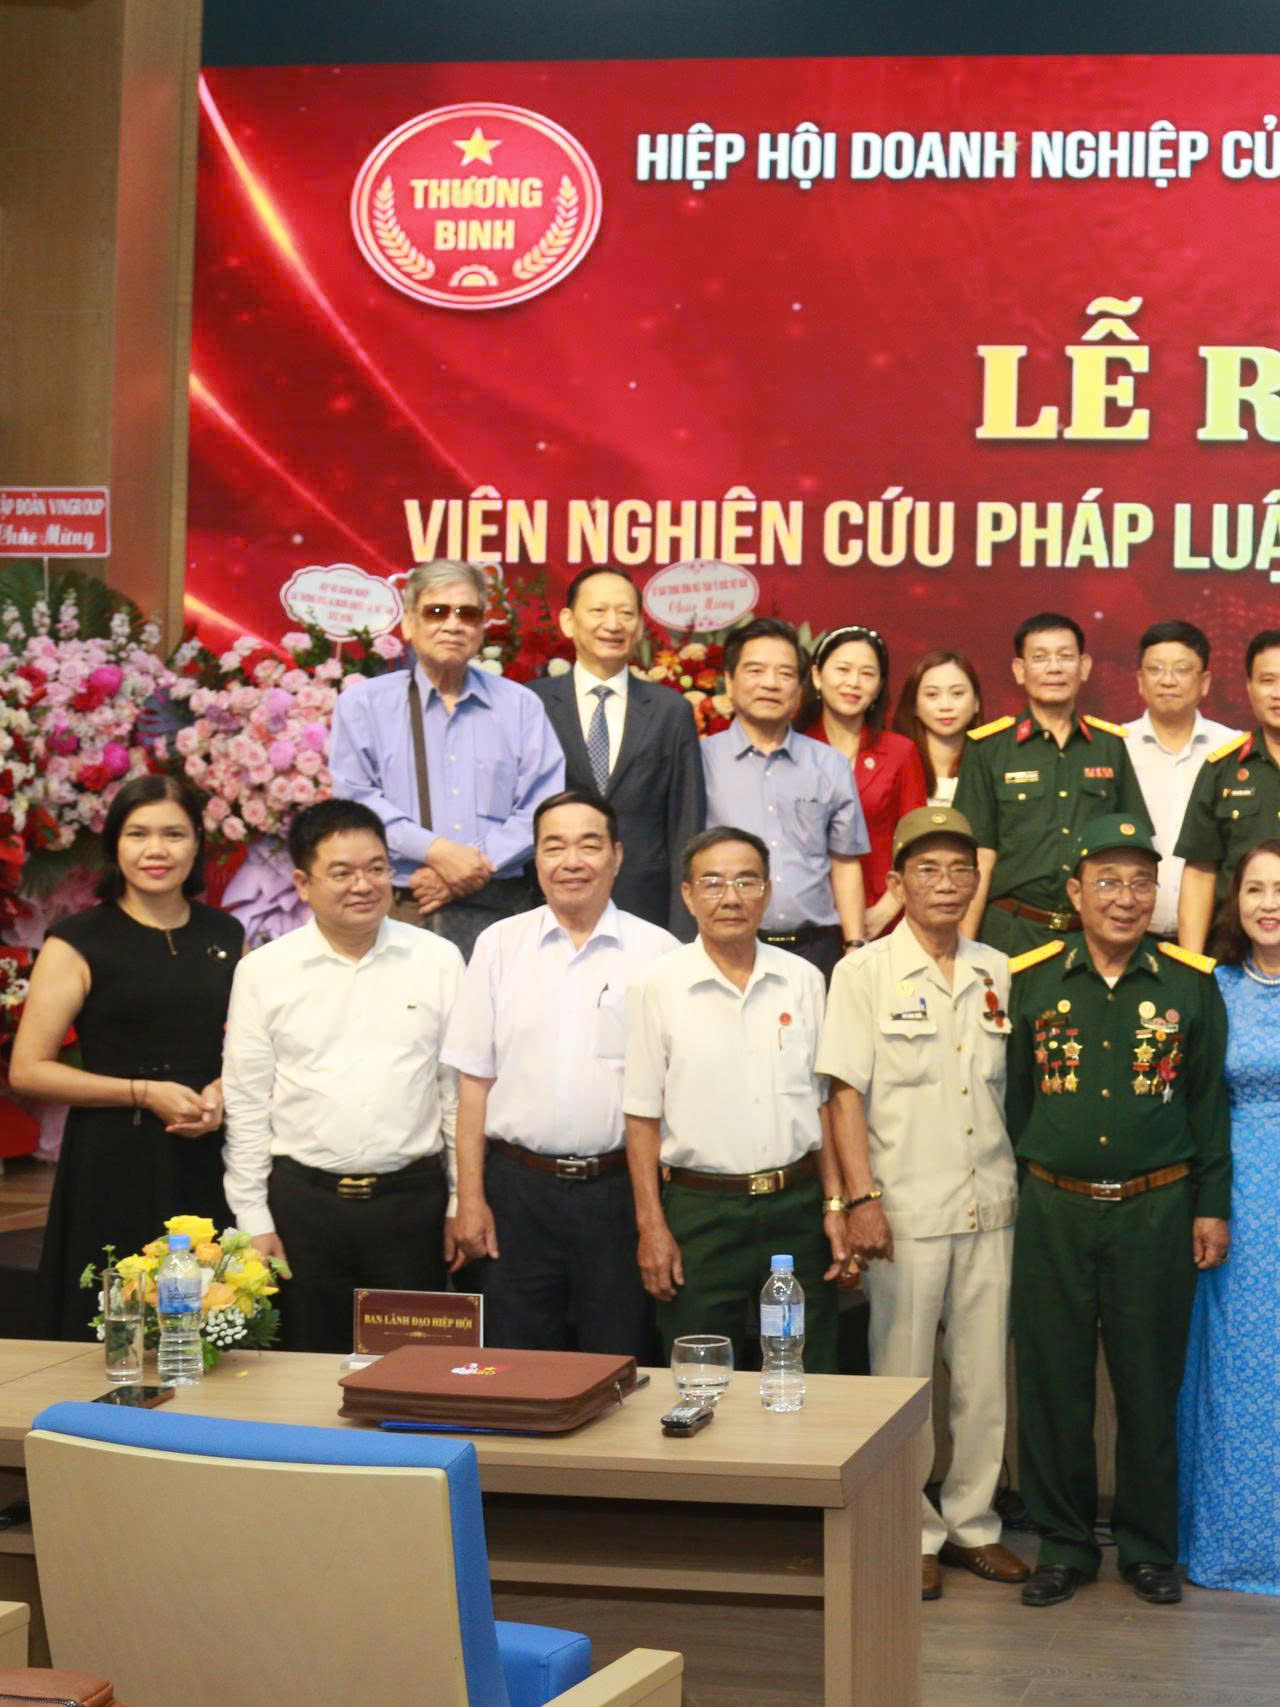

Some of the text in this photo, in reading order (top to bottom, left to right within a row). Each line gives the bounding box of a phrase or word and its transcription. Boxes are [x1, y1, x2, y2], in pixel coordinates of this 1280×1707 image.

[636, 122, 746, 190] HIỆP
[757, 121, 837, 190] HỘI
[850, 131, 1017, 179] DOANH
[1030, 119, 1209, 188] NGHIỆP
[410, 175, 543, 209] THƯƠNG
[434, 219, 516, 251] BINH
[975, 296, 1150, 440] LỄ
[0, 493, 14, 519] ẬP
[568, 486, 803, 565] NGHIÊN
[823, 486, 955, 567] CỨU
[976, 487, 1154, 569] PHÁP
[364, 1312, 473, 1331] BAN LÃNH ĐẠO HIỆP HỘI
